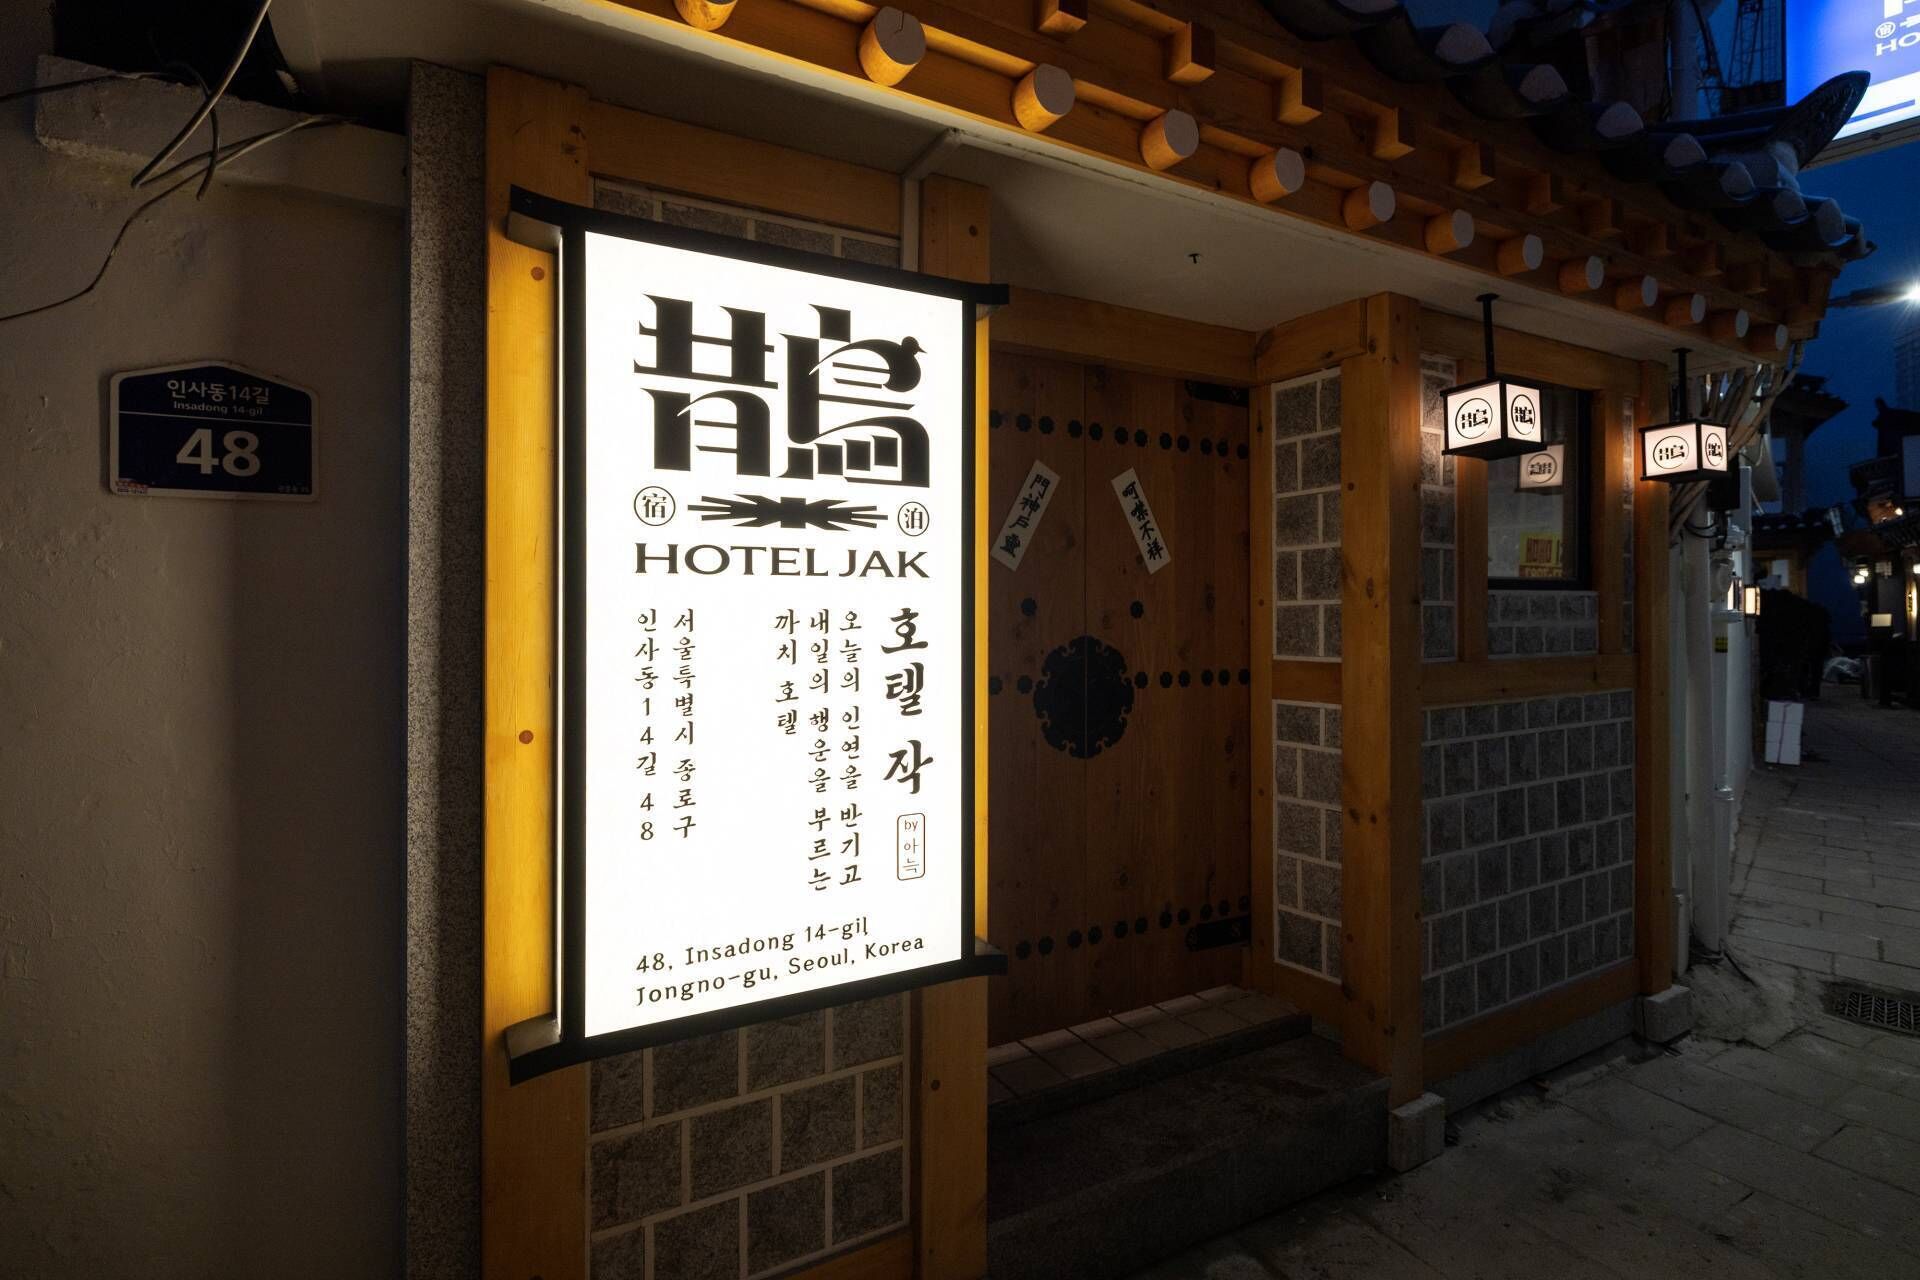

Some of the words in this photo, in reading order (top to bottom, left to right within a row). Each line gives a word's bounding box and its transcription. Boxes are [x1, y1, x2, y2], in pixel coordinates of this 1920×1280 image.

[167, 379, 270, 406] 인사동14길
[173, 400, 228, 416] Insadong
[232, 405, 264, 417] 14-gil
[176, 428, 261, 477] 48
[635, 543, 829, 576] HOTEL
[838, 549, 930, 578] JAK
[774, 608, 801, 666] 까치
[809, 608, 830, 694] 내일의
[839, 610, 862, 693] 오늘의
[880, 607, 929, 717] 호텔
[634, 608, 660, 777] 인사동14길
[672, 607, 697, 745] 서울특별시
[775, 680, 800, 735] 호텔
[808, 707, 831, 793] 행운을
[839, 705, 862, 790] 인연을
[882, 739, 934, 795] 작
[639, 792, 655, 841] 48
[672, 758, 697, 839] 종로구
[904, 819, 918, 833] by
[807, 807, 831, 892] 부르는
[839, 802, 863, 886] 반기고
[902, 837, 921, 875] 아늑
[636, 952, 673, 974] 48,
[685, 933, 795, 966] Insadong
[805, 916, 869, 943] 14-gil
[636, 967, 778, 1006] Jongno-gu,
[788, 947, 855, 975] Seoul,
[865, 937, 924, 960] Korea
